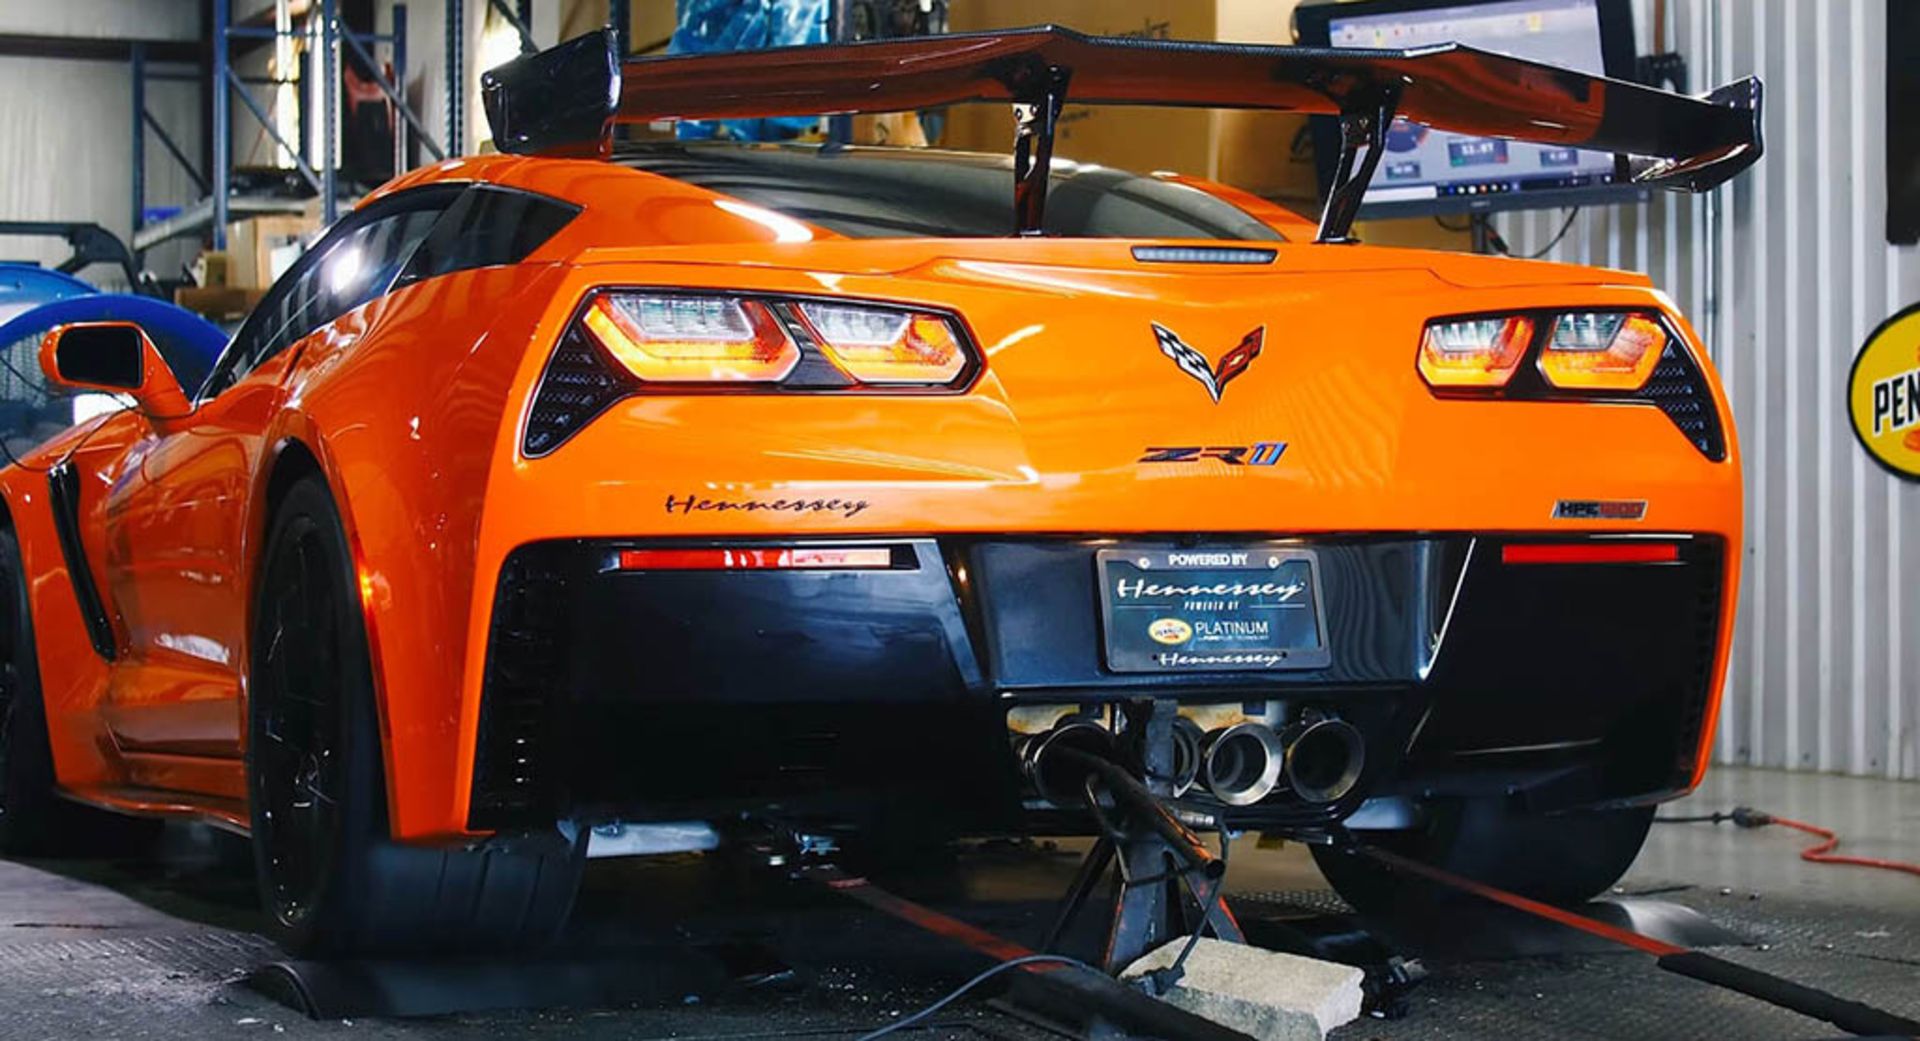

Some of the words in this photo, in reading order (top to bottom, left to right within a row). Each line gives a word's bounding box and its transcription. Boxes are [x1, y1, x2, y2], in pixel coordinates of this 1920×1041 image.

[1138, 442, 1288, 465] ZR1
[665, 494, 870, 518] Hennessey
[1168, 554, 1230, 566] POWERED
[1232, 553, 1248, 565] BY
[1117, 579, 1302, 601] Hennessey
[1184, 601, 1224, 611] POWERED
[1195, 621, 1268, 635] PLATINUM
[1160, 653, 1281, 667] Hennessey
